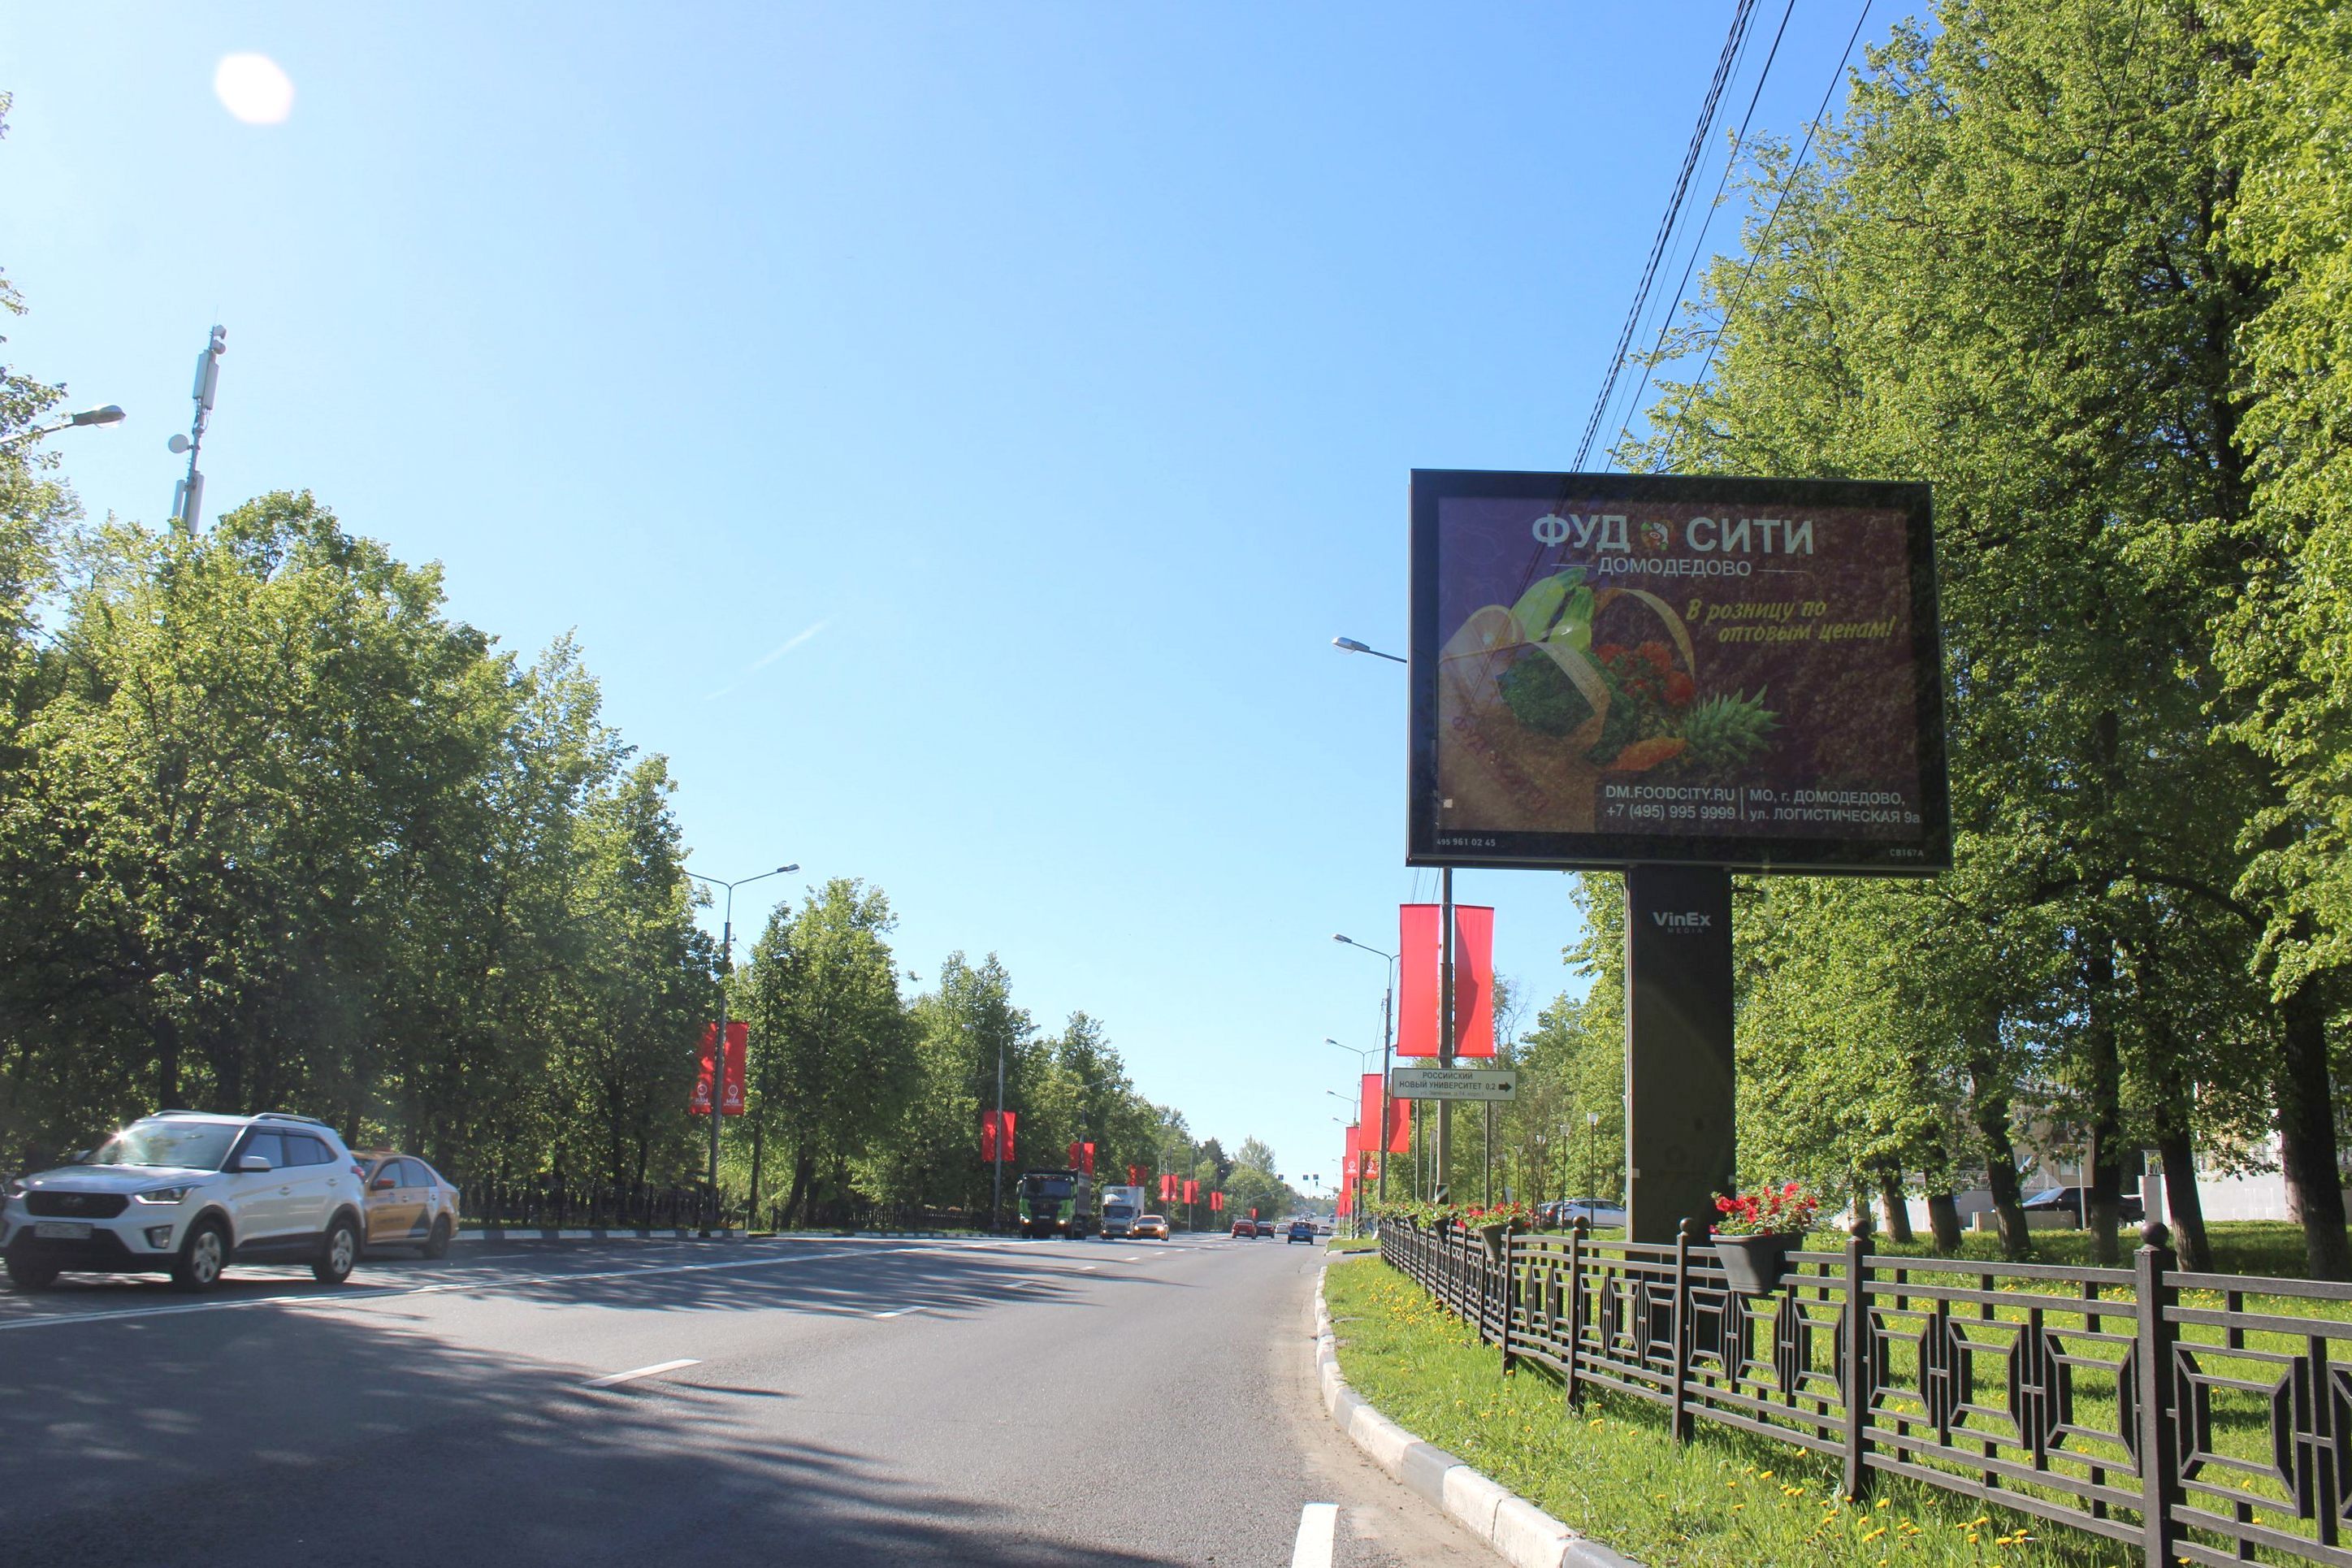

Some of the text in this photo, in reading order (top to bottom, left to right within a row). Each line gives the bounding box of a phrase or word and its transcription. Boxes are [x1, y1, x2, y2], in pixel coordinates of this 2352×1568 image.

[1531, 513, 1814, 555] ФУД СИТИ
[1597, 557, 1752, 578] ДОМОДЕДОВО
[1685, 598, 1827, 626] В розницу по
[1718, 615, 1897, 643] оптовым ценам!
[1605, 786, 1735, 801] DM.FOODCITY.RU
[1749, 789, 1906, 806] МО, г. ДОМОДЕДОВО,
[1606, 803, 1736, 821] +7 (495) 995 9999
[1749, 810, 1769, 822] ул.
[1774, 808, 1900, 823] ЛОГИСТИЧЕСКАЯ
[1471, 838, 1483, 847] 02
[1652, 912, 1711, 926] VinEx
[1422, 1071, 1473, 1080] РОССИЙСКИЙ
[1399, 1080, 1427, 1088] НОВЫЙ
[1429, 1081, 1482, 1090] УНИВЕРСИТЕТ
